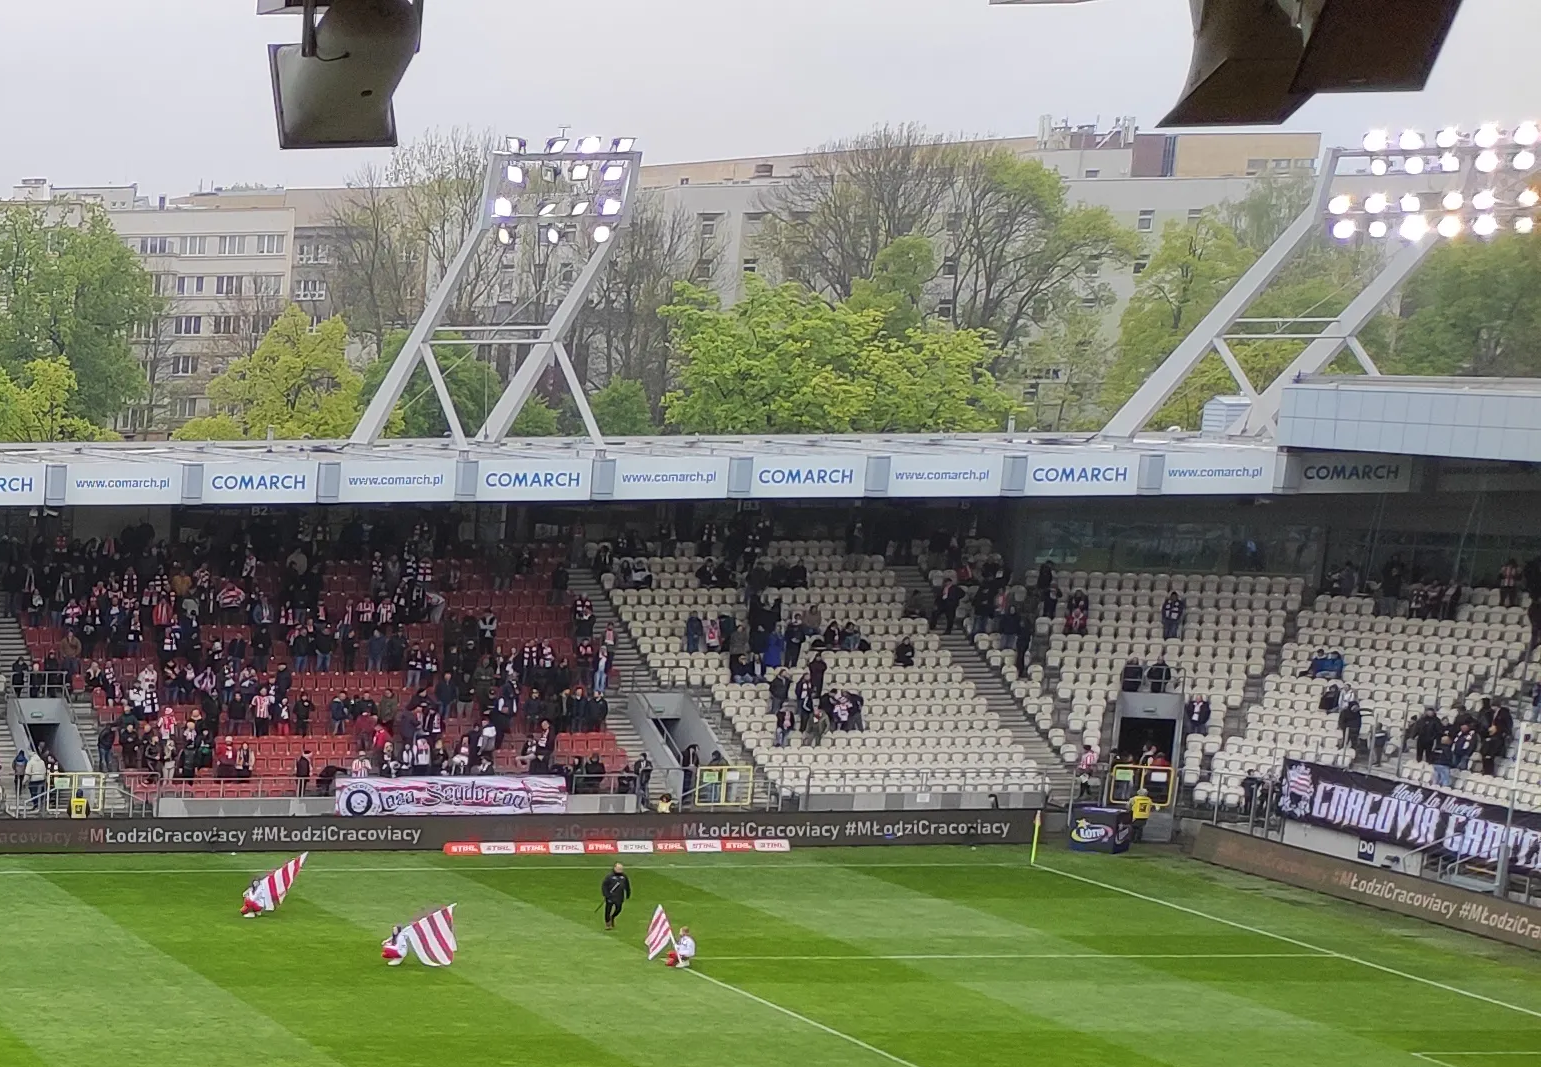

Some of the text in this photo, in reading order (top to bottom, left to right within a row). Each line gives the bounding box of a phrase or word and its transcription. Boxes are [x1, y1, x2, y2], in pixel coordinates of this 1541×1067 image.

[622, 471, 717, 485] www.comarch.pl
[758, 469, 854, 484] COMARCH
[895, 469, 990, 483] www.comarch.pl
[1032, 467, 1128, 482] COMARCH
[1168, 466, 1263, 479] www.comarch.pl
[1303, 464, 1399, 480] COMARCH
[76, 478, 171, 491] www.comarch.pl
[211, 475, 307, 489] COMARCH
[348, 474, 444, 488] www.comarch.pl
[485, 473, 581, 487] COMARCH
[77, 826, 247, 846] #MŁodziCracoviacy
[252, 824, 422, 845] #MŁodziCracoviacy
[671, 820, 840, 841] #MŁodziCracoviacy
[844, 818, 1011, 839] #MŁodziCracoviacy
[1334, 868, 1459, 920] #MŁodziCracoviacy
